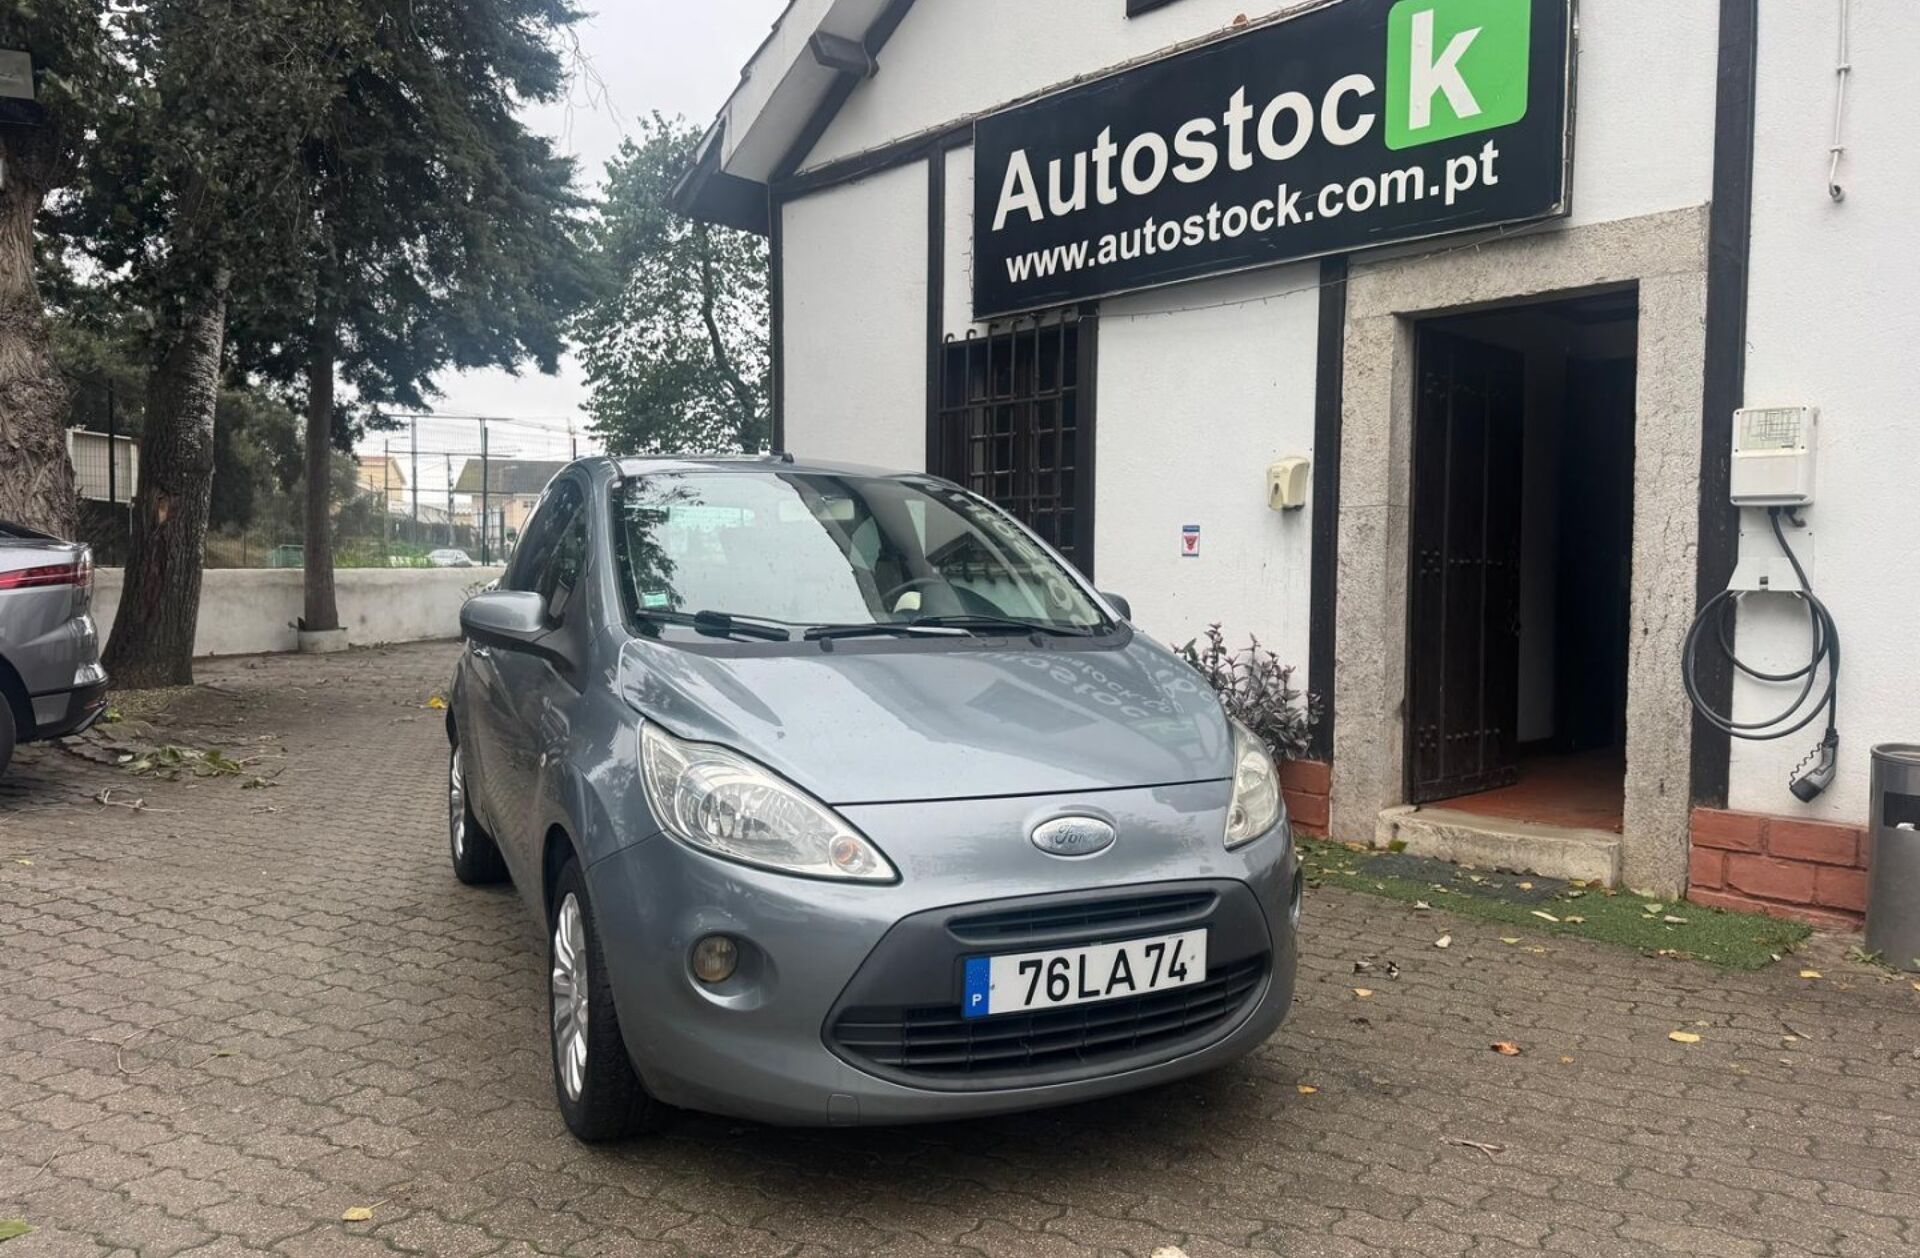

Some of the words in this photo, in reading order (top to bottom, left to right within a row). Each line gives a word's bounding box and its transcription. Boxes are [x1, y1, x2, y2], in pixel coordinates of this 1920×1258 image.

[991, 8, 1484, 231] Autostock
[1005, 139, 1500, 283] www.autostock.com.pt
[971, 993, 983, 1007] P
